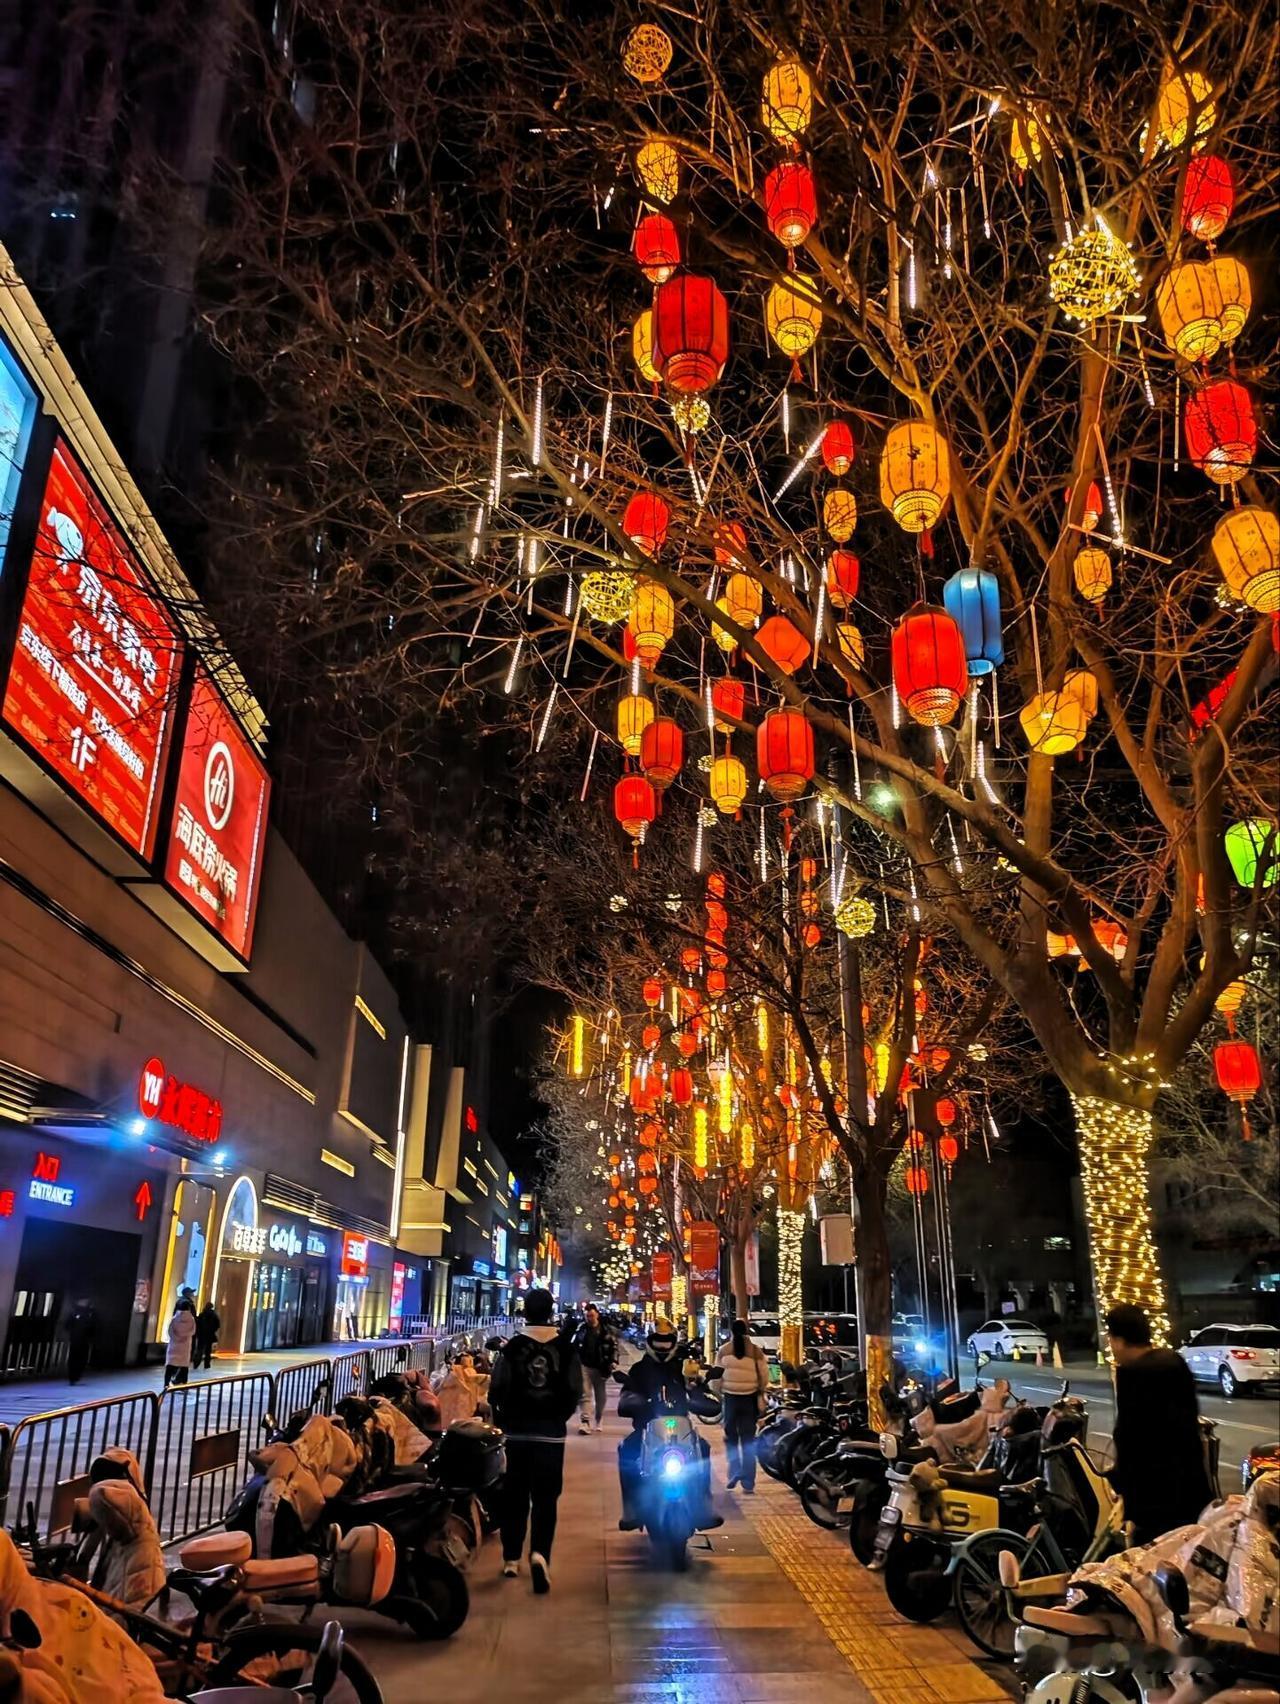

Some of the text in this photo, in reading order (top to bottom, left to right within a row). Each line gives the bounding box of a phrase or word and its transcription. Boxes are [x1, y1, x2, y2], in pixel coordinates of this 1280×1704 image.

[70, 726, 97, 772] 1F
[175, 802, 239, 904] 海底捞火锅
[144, 1071, 163, 1107] YH
[33, 1152, 60, 1182] 入口
[29, 1180, 74, 1206] ENTRANCE
